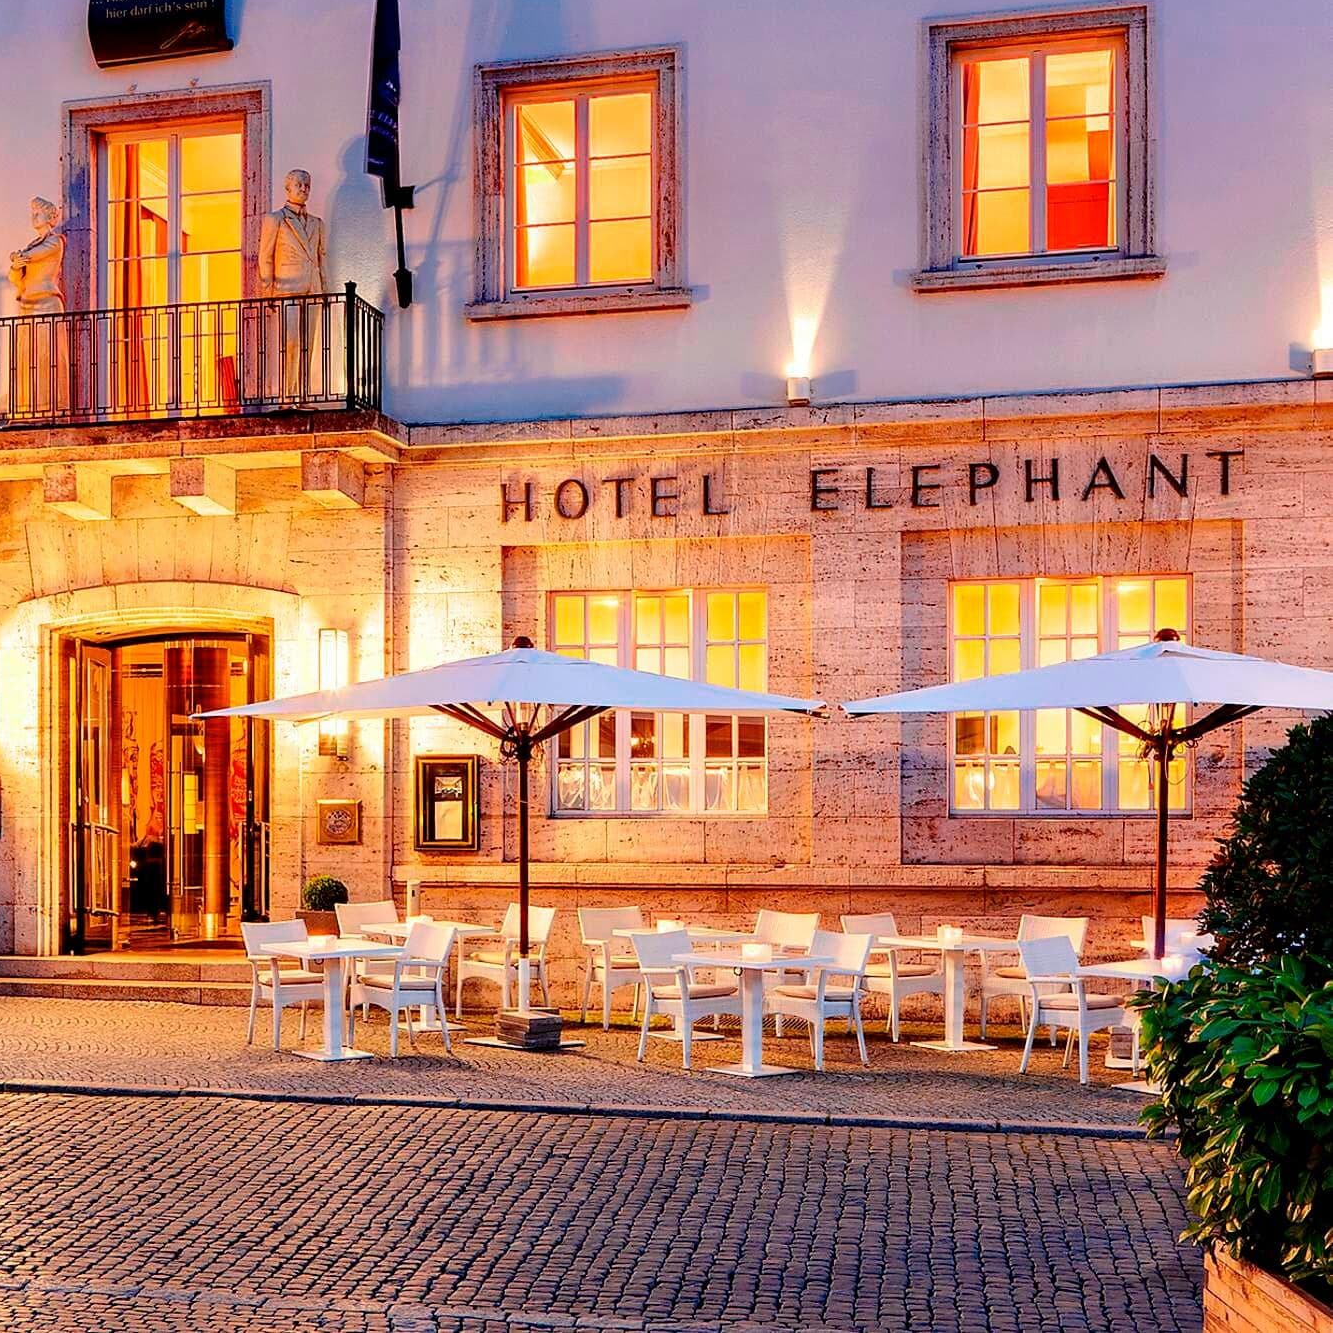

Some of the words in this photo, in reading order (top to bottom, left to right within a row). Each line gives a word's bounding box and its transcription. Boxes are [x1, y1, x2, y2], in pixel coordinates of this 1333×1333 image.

[106, 8, 128, 19] hier
[129, 5, 152, 16] darf
[184, 0, 208, 10] sein
[500, 474, 730, 523] HOTEL
[810, 449, 1245, 511] ELEPHANT
